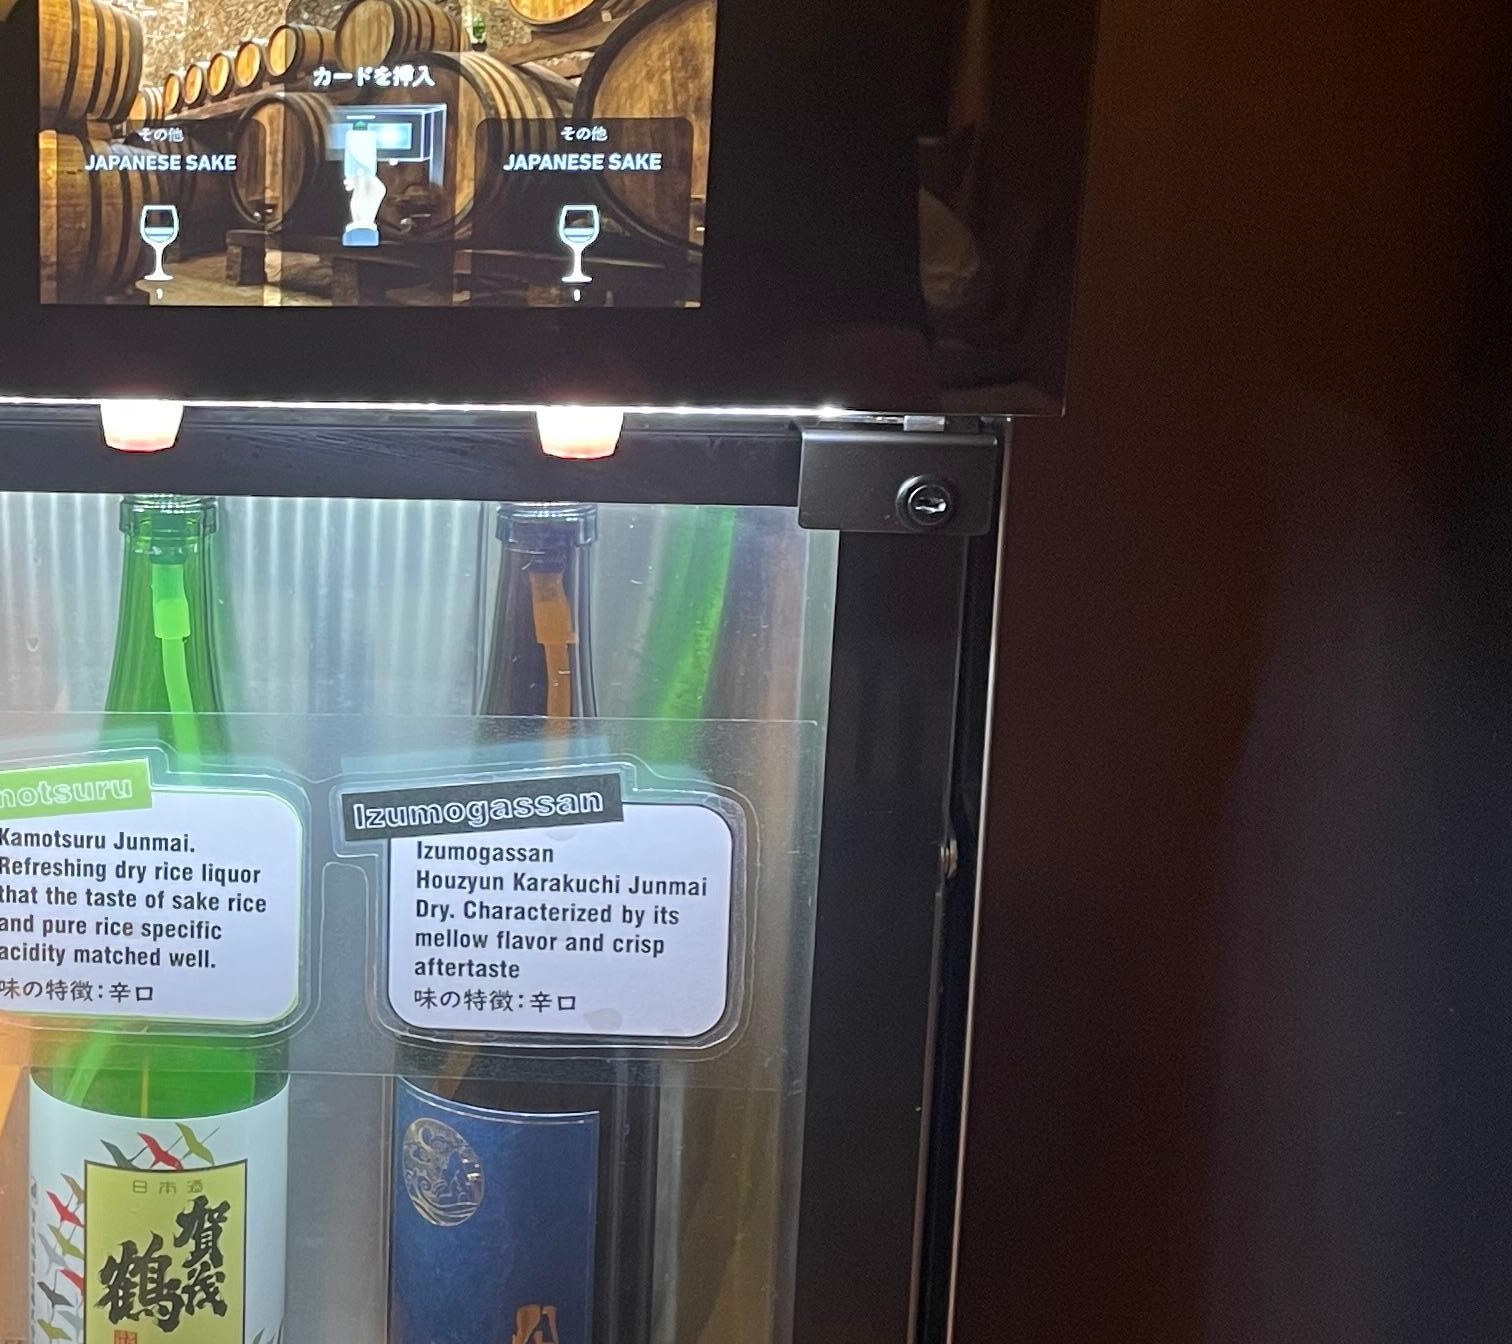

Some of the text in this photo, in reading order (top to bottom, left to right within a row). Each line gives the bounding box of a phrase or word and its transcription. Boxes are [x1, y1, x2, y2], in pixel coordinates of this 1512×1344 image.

[138, 125, 184, 143] その他
[560, 124, 608, 142] その他
[85, 153, 237, 172] JAPANESE SAKE
[504, 152, 661, 172] JAPANESE SAKE
[354, 790, 603, 830] Izumogassan
[113, 830, 195, 853] Junmai.
[417, 840, 554, 865] Izumogassan
[202, 863, 261, 887] liquor
[416, 870, 707, 897] Houzyun Karakuchi Junmai
[85, 887, 137, 908] taste
[172, 890, 220, 911] sake
[416, 900, 611, 924] Dry. Characterized
[140, 919, 222, 942] specific
[415, 929, 665, 958] mellow flavor and crisp
[74, 945, 161, 967] matched
[169, 949, 217, 969] well.
[415, 958, 520, 979] aftertaste
[414, 988, 576, 1012] 味の特徴：辛口
[132, 1179, 204, 1195] 日本酒
